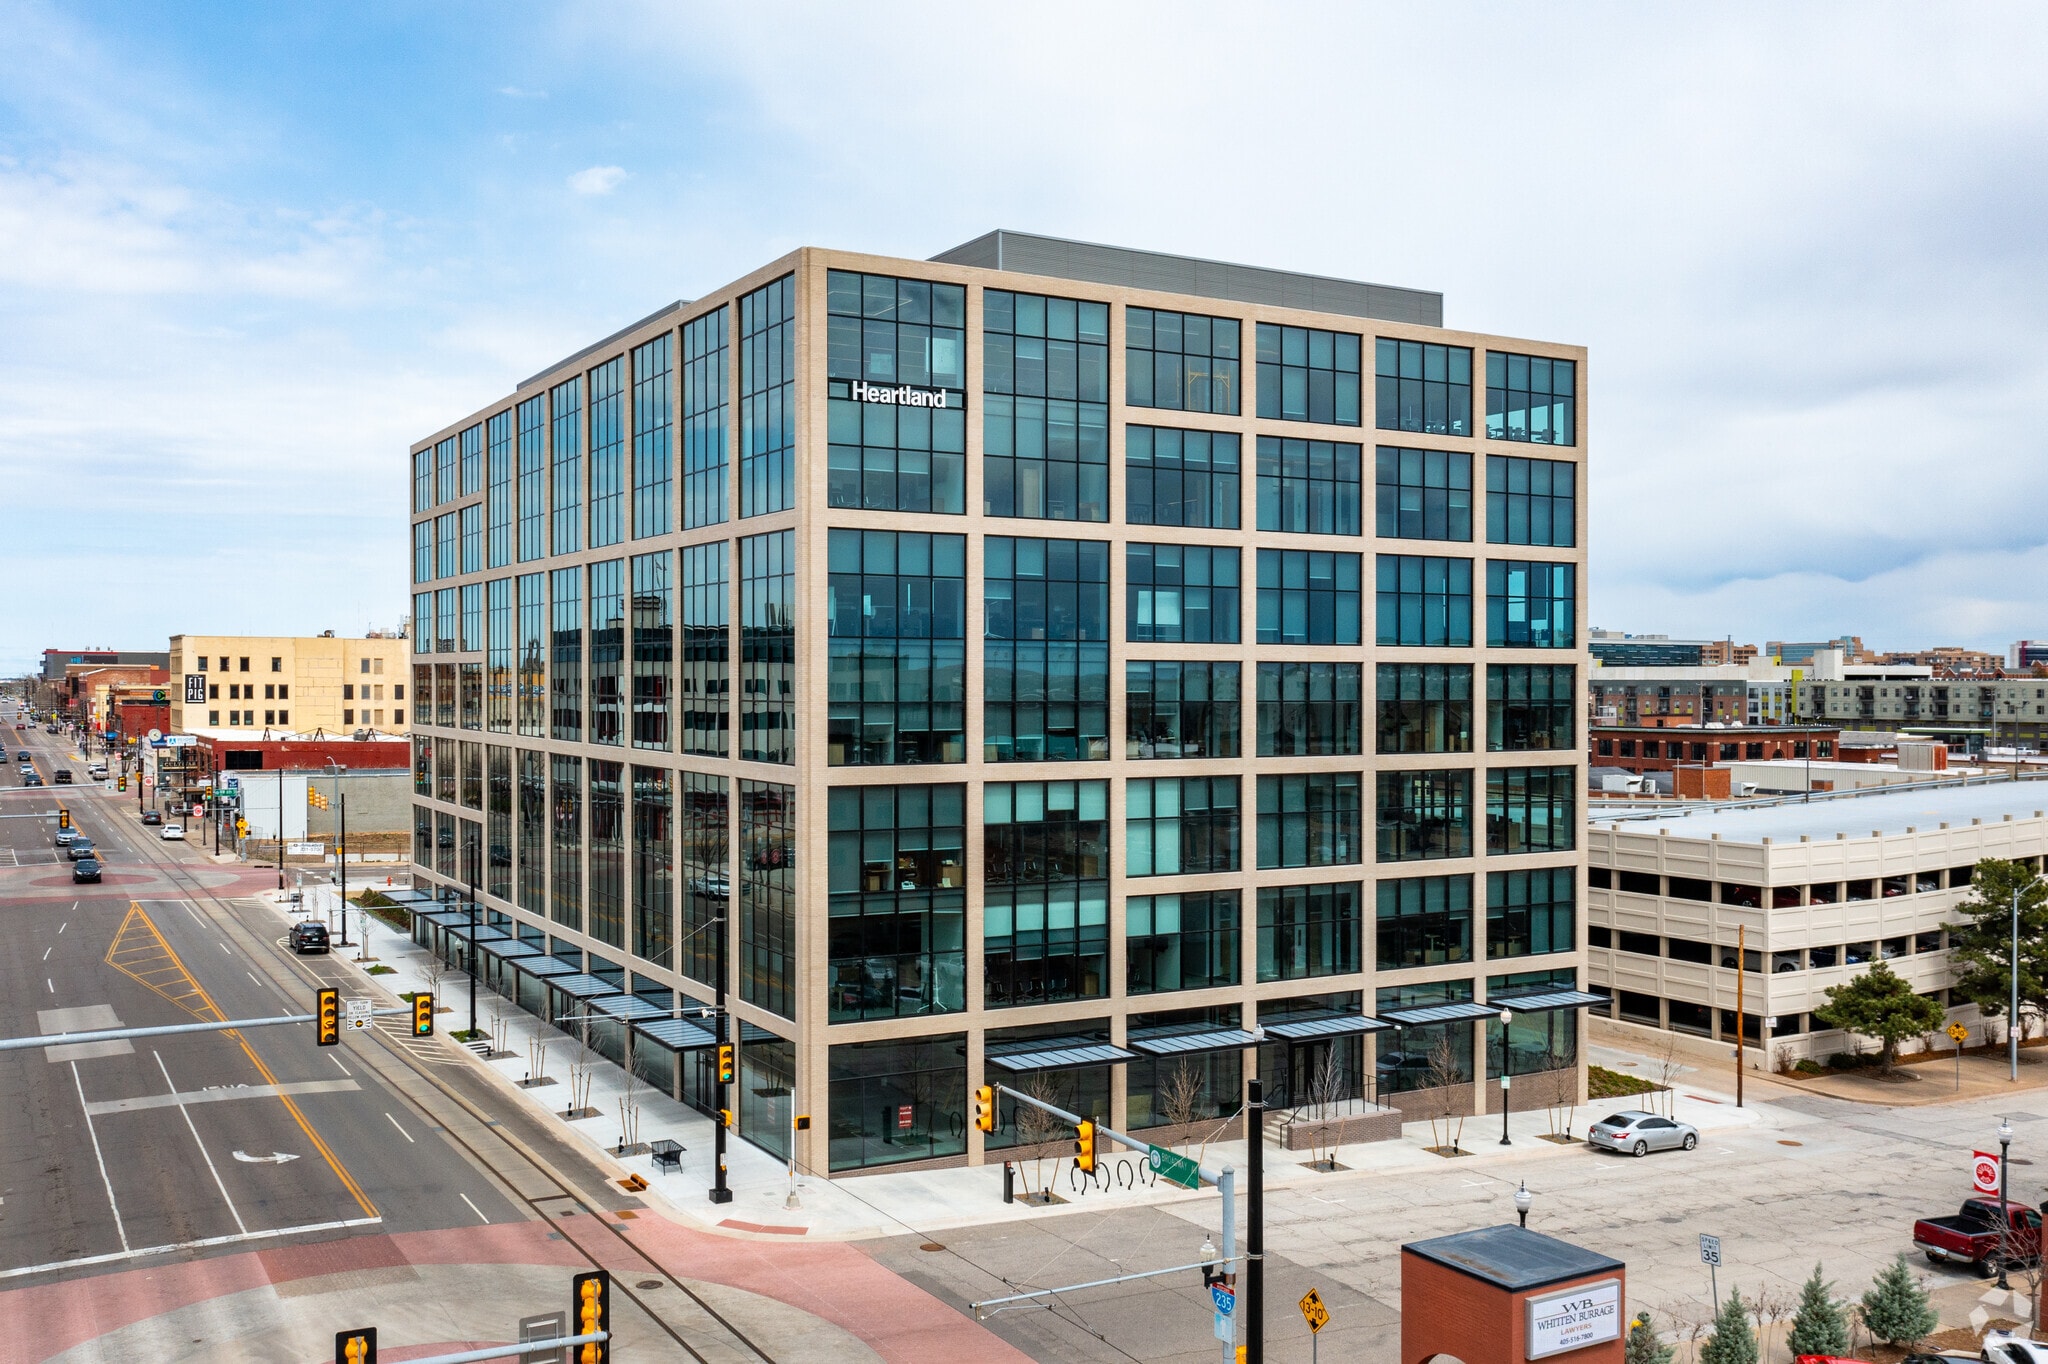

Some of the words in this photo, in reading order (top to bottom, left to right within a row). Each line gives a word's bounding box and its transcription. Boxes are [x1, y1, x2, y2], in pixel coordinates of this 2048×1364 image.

[852, 380, 946, 408] Heartland
[188, 677, 204, 688] FIT
[188, 688, 204, 700] PIG
[1161, 1152, 1188, 1171] BROADWAY
[1701, 1236, 1718, 1246] SPEED
[1703, 1242, 1717, 1251] LIMIT
[1703, 1249, 1719, 1263] 35
[1216, 1292, 1232, 1311] 235
[1562, 1299, 1594, 1313] WB
[1538, 1313, 1577, 1331] WHITTEN
[1578, 1304, 1615, 1322] BURRAGE
[1560, 1322, 1592, 1336] LAWYERS
[1559, 1332, 1594, 1346] 405-516-7800
